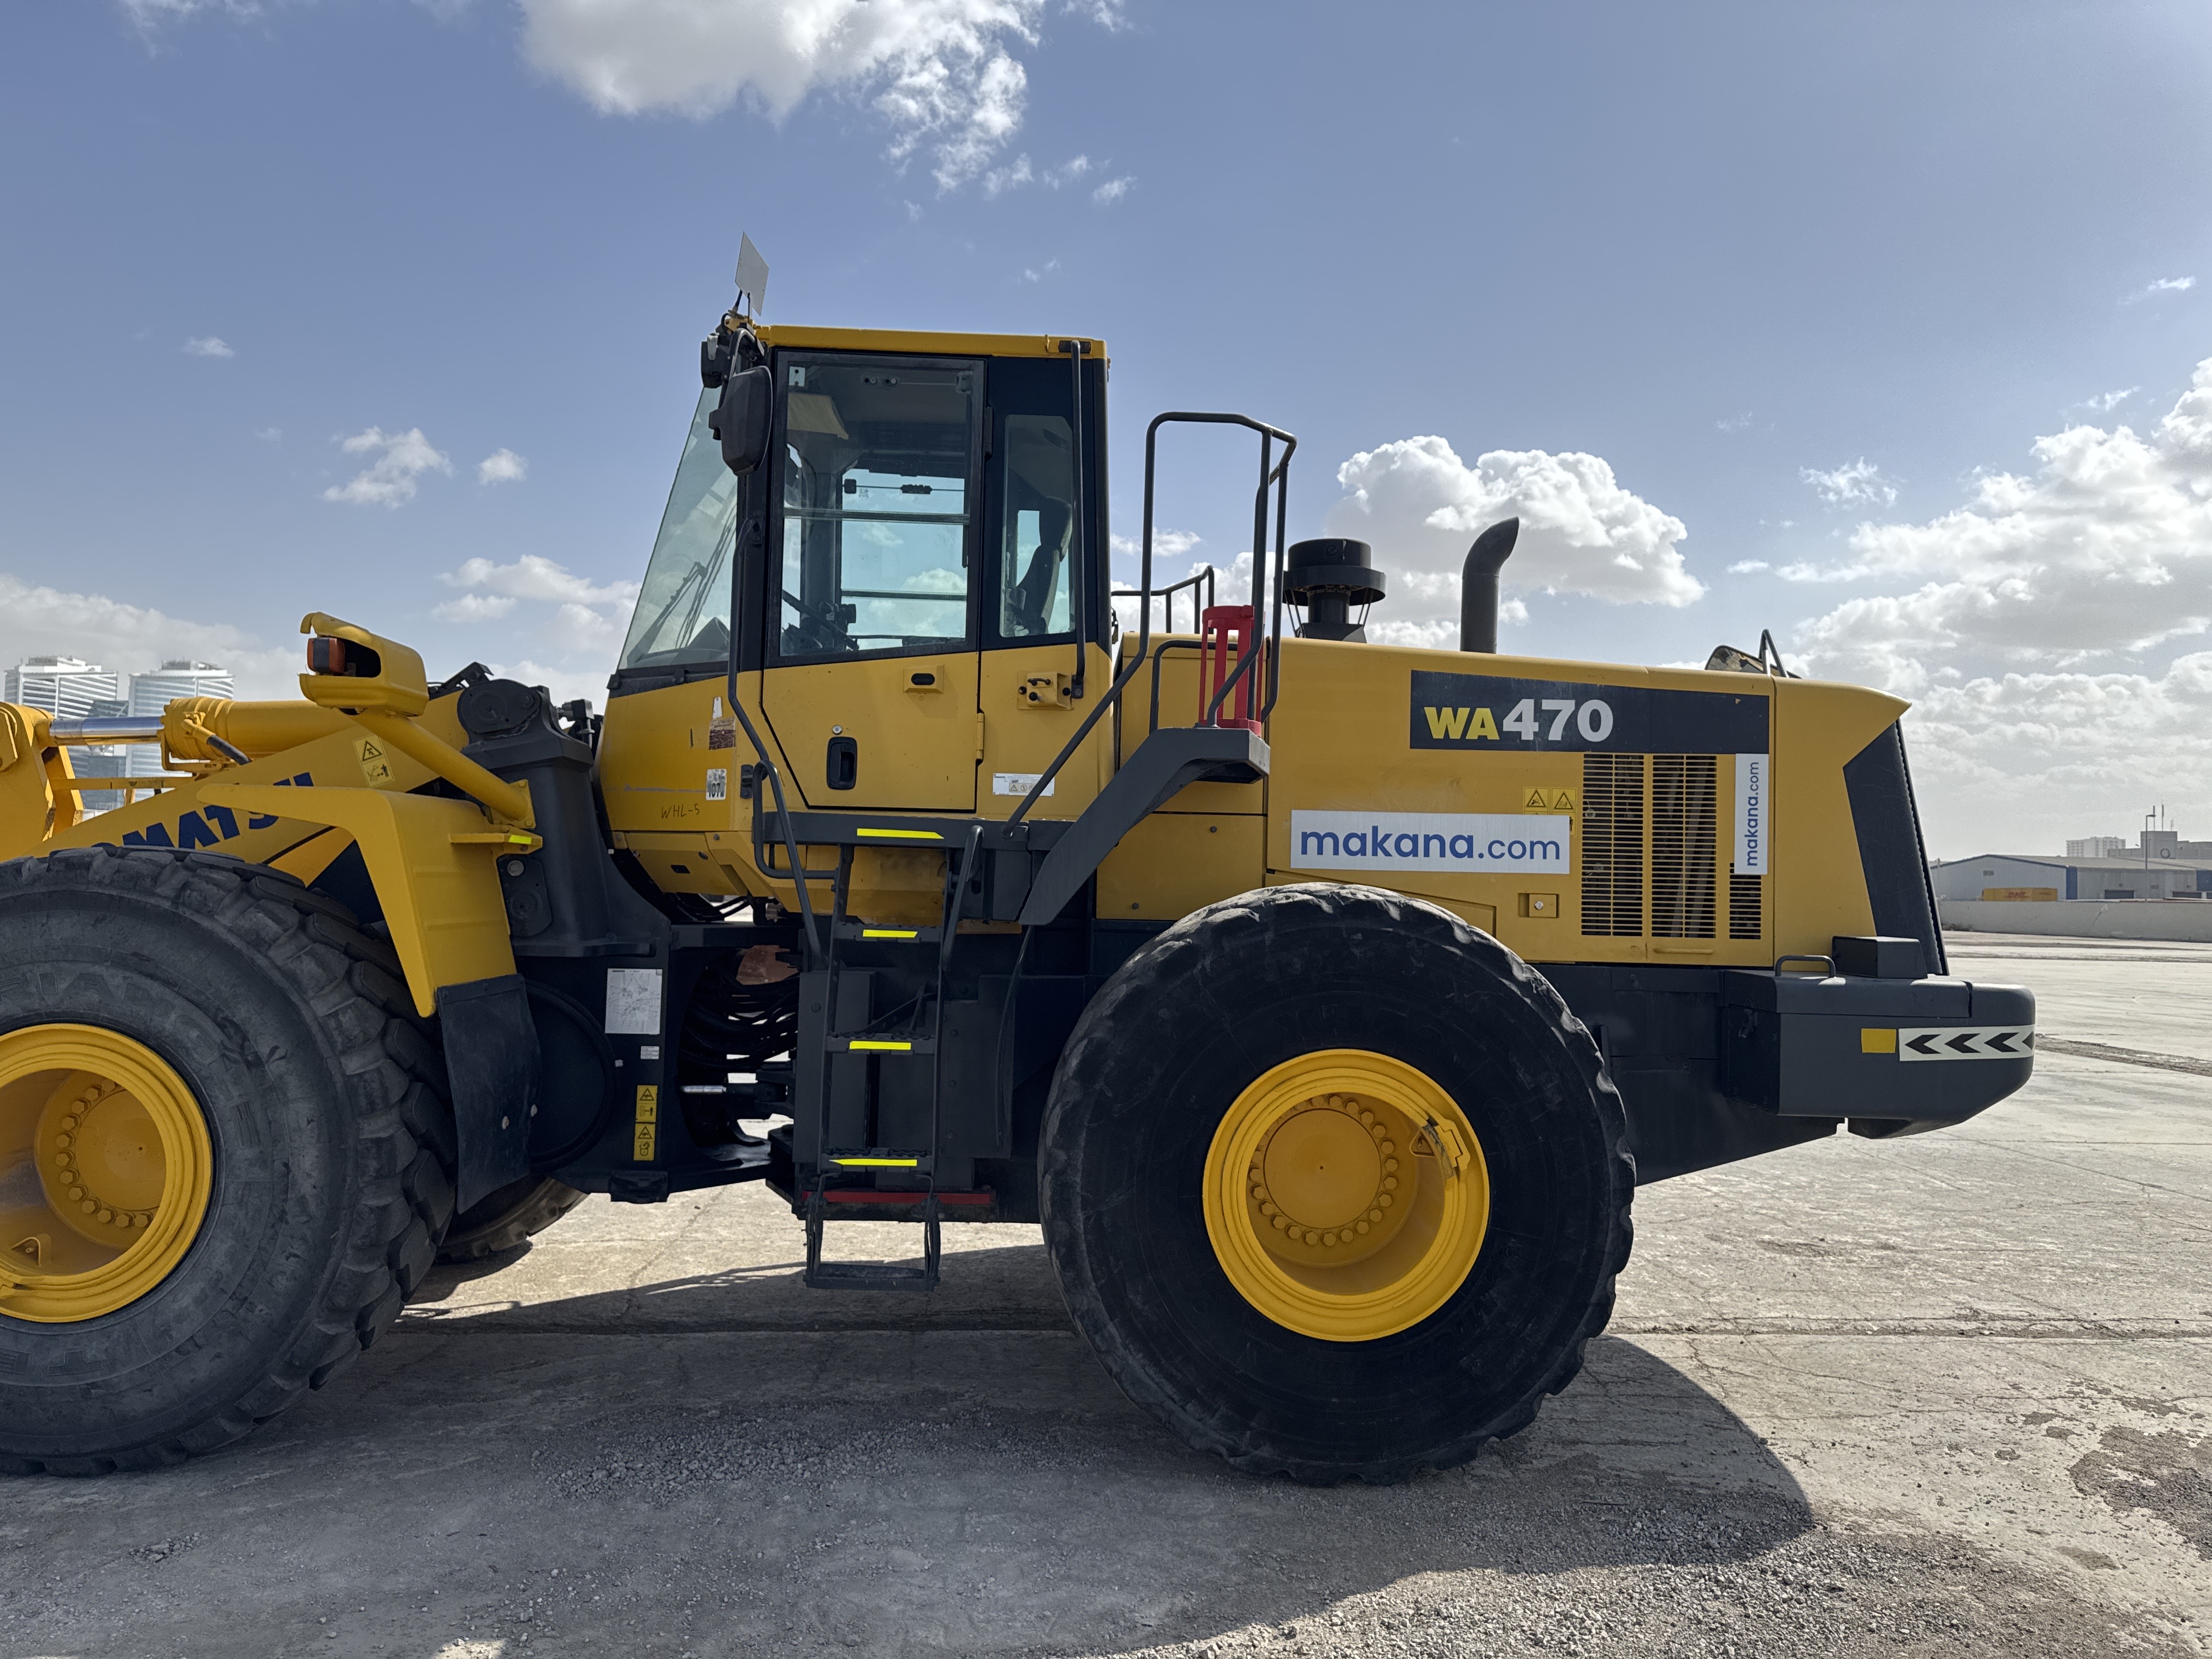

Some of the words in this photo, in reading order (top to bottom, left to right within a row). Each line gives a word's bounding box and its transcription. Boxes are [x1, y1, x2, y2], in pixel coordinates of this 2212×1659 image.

[1424, 698, 1613, 742] WA470
[661, 803, 700, 819] WHL-5
[1744, 761, 1759, 866] makana.com
[1301, 825, 1560, 860] makana.com
